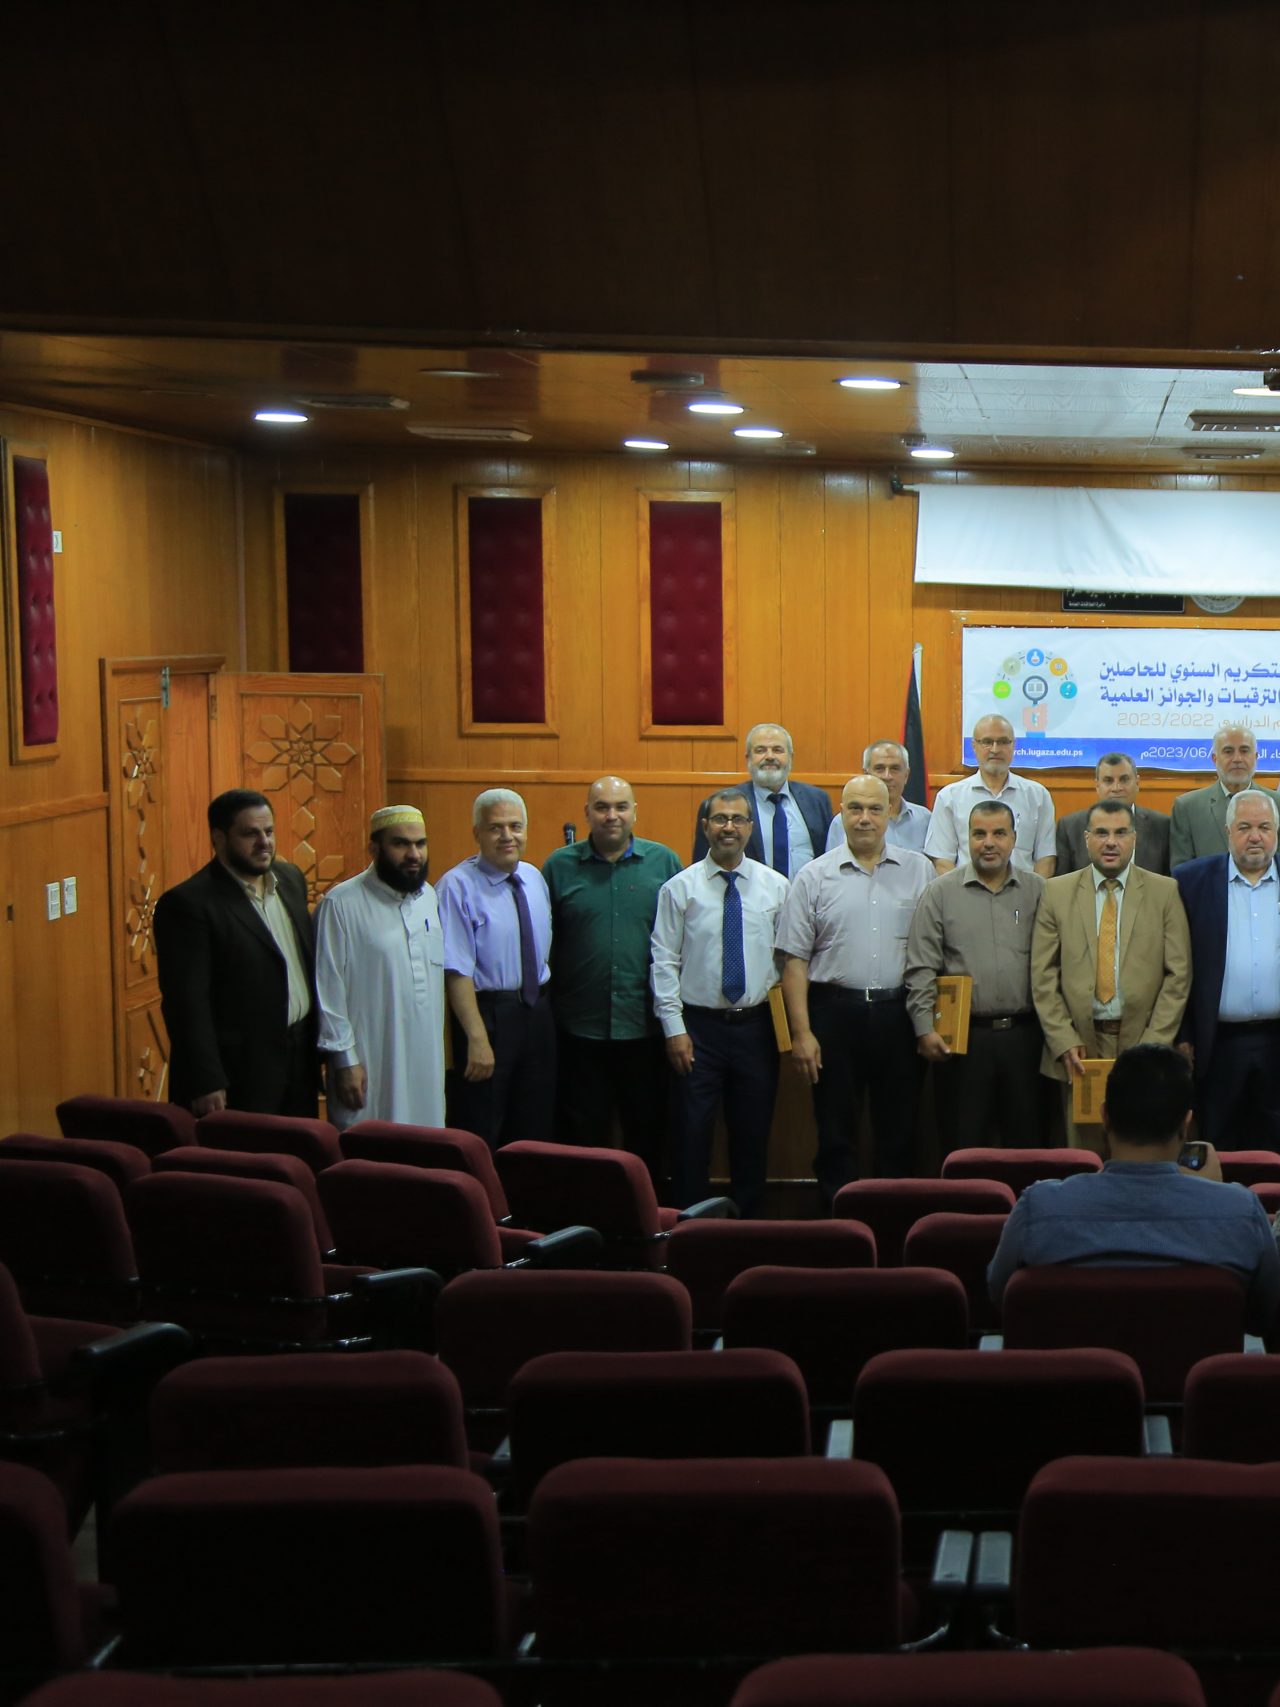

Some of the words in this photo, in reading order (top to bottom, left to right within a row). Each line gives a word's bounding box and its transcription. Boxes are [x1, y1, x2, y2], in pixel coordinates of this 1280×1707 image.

[1099, 660, 1166, 682] للحاصلين
[1170, 661, 1220, 683] السنوي
[1100, 685, 1154, 708] العلمية
[1157, 687, 1214, 708] والجوائز
[1116, 712, 1215, 728] 2023/2022
[1013, 748, 1084, 758] rch.iugaza.edu.ps
[1140, 746, 1214, 760] 2023/06/م
